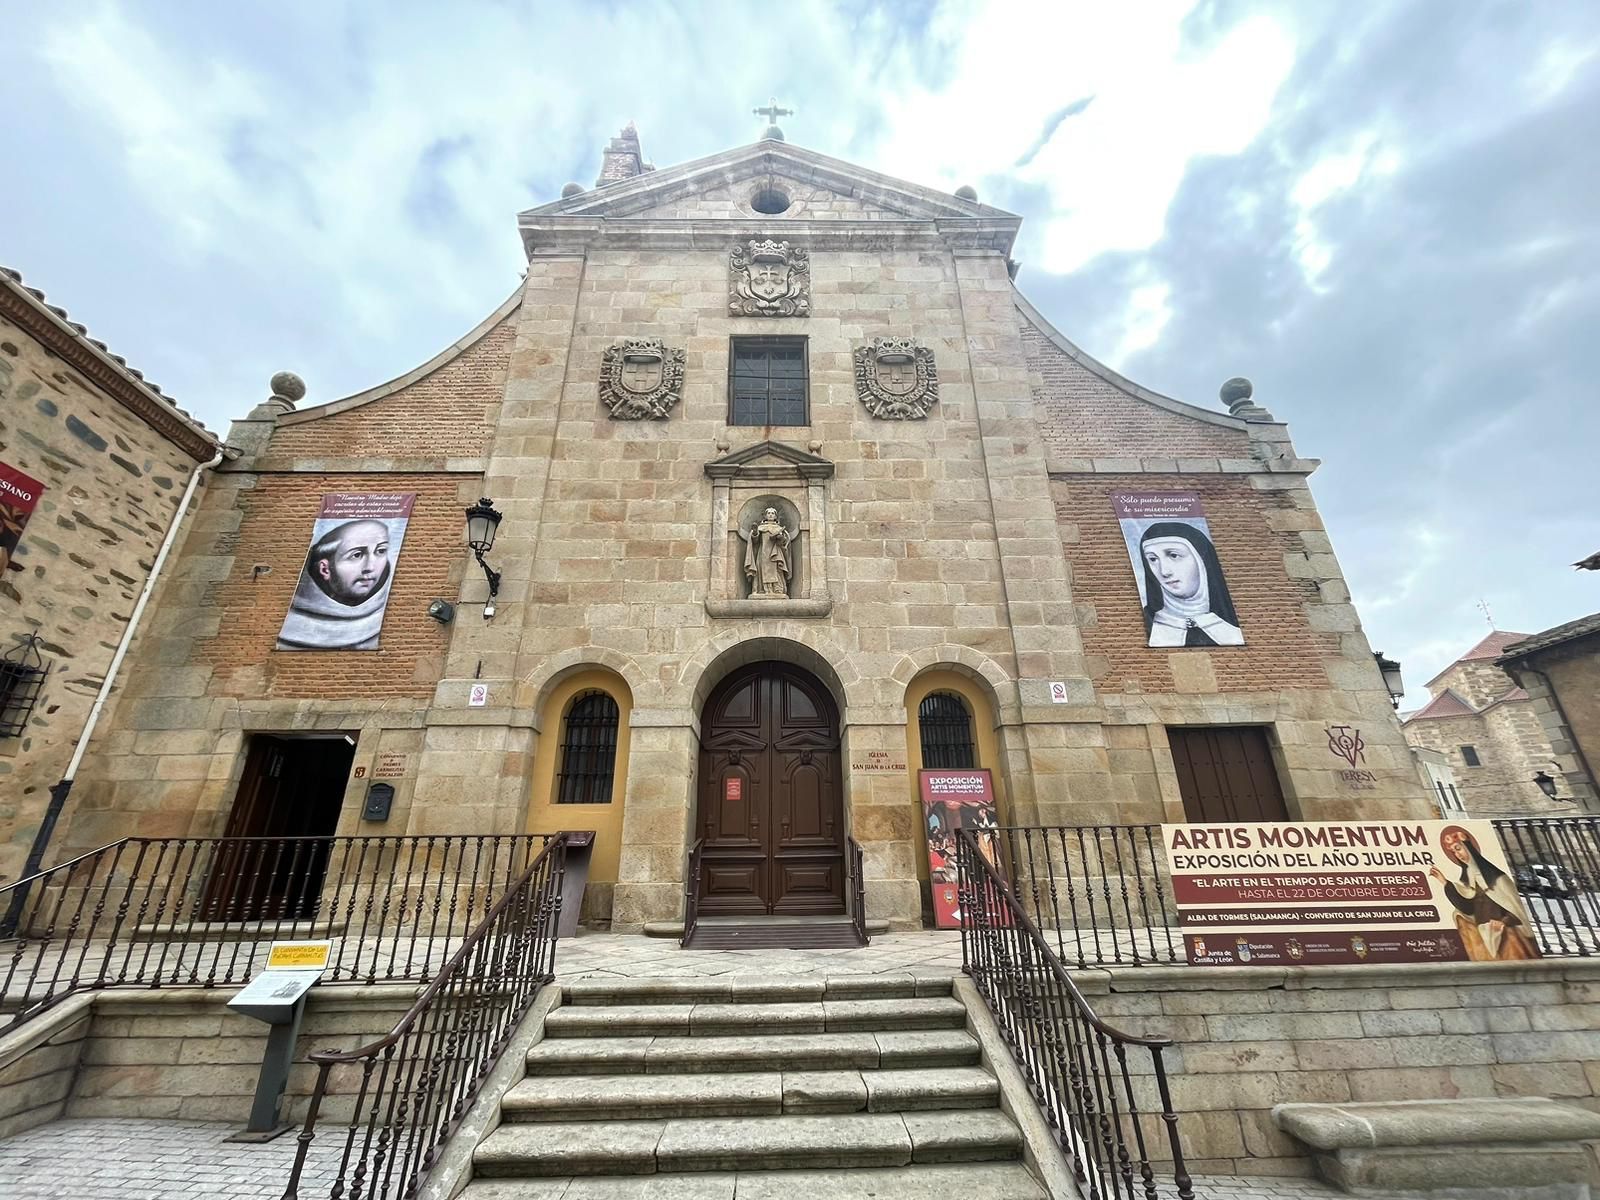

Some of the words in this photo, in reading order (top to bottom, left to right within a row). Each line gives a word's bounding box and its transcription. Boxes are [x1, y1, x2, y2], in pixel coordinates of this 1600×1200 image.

[929, 776, 983, 784] EXPOSICIÓN
[1171, 828, 1252, 850] ARTIS
[1257, 826, 1428, 848] MOMENTUM
[1173, 850, 1280, 869] EXPOSICIÓN
[1283, 854, 1318, 867] DEL
[1322, 849, 1359, 867] AÑO
[1362, 852, 1435, 866] JUBILAR
[1212, 878, 1241, 887] ARTE
[1243, 878, 1259, 887] EN
[1261, 878, 1274, 887] EL
[1274, 877, 1317, 887] TIEMPO
[1319, 877, 1335, 886] DE
[1336, 876, 1374, 885] SANTA
[1238, 889, 1275, 899] HASTA
[1276, 889, 1291, 898] EL
[1292, 889, 1305, 898] 22
[1307, 888, 1324, 898] DE
[1326, 888, 1380, 897] OCTUBRE
[1382, 887, 1398, 896] DE
[1400, 887, 1426, 896] 2023
[1219, 913, 1249, 921] TORMES
[1250, 912, 1299, 921] (SALAMANCA)
[1345, 911, 1356, 919] DE
[1357, 911, 1371, 919] SAN
